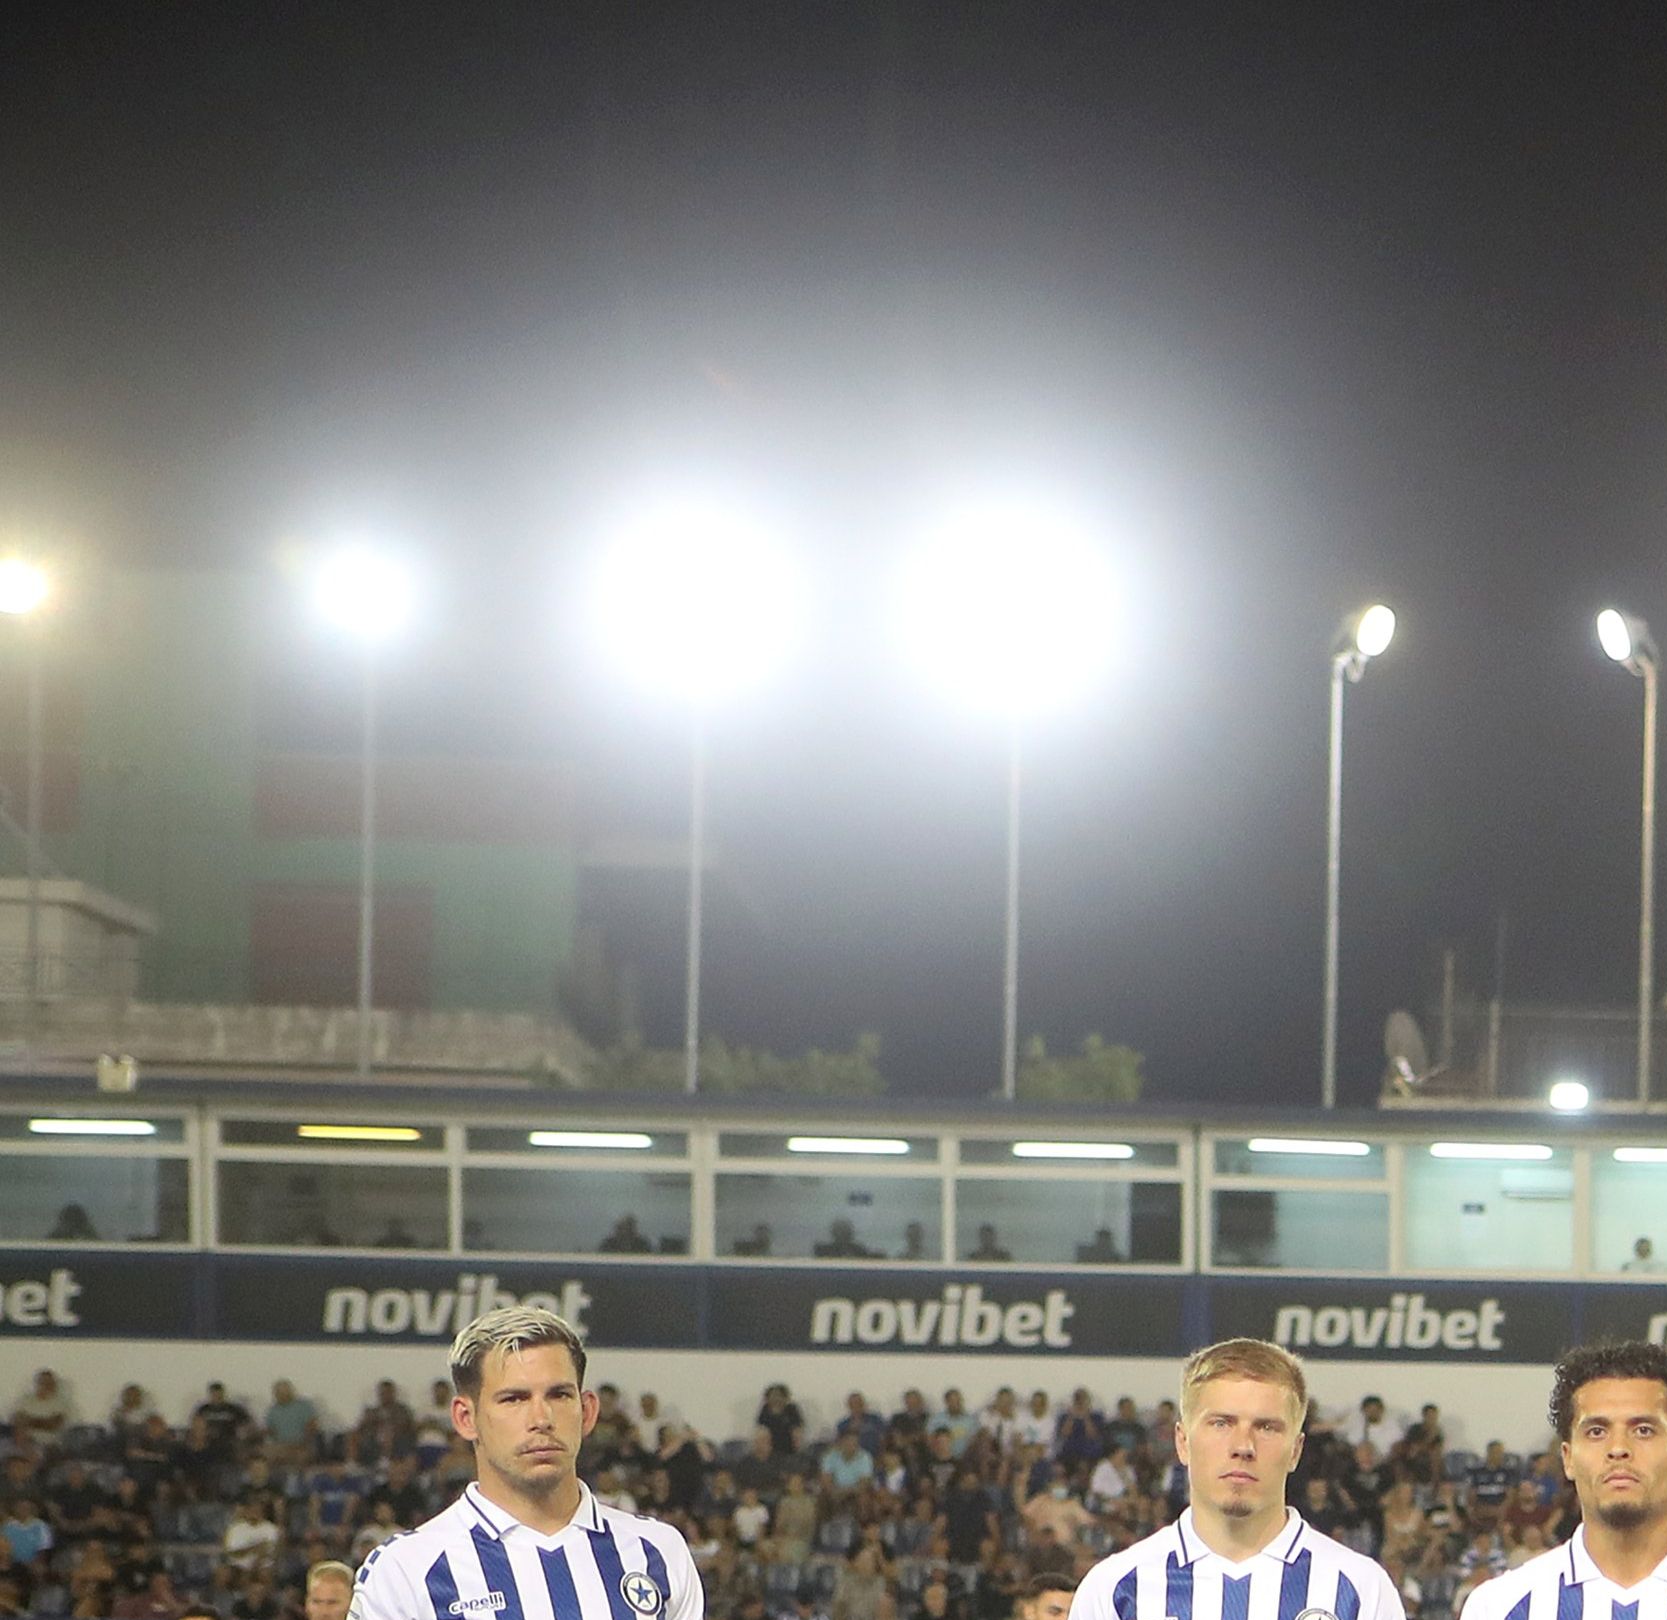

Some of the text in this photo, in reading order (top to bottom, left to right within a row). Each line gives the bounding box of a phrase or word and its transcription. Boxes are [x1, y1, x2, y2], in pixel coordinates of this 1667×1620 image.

[0, 1269, 80, 1327] et
[811, 1284, 1074, 1347] novibet
[1275, 1293, 1505, 1349] novibet
[451, 1593, 503, 1612] capelli
